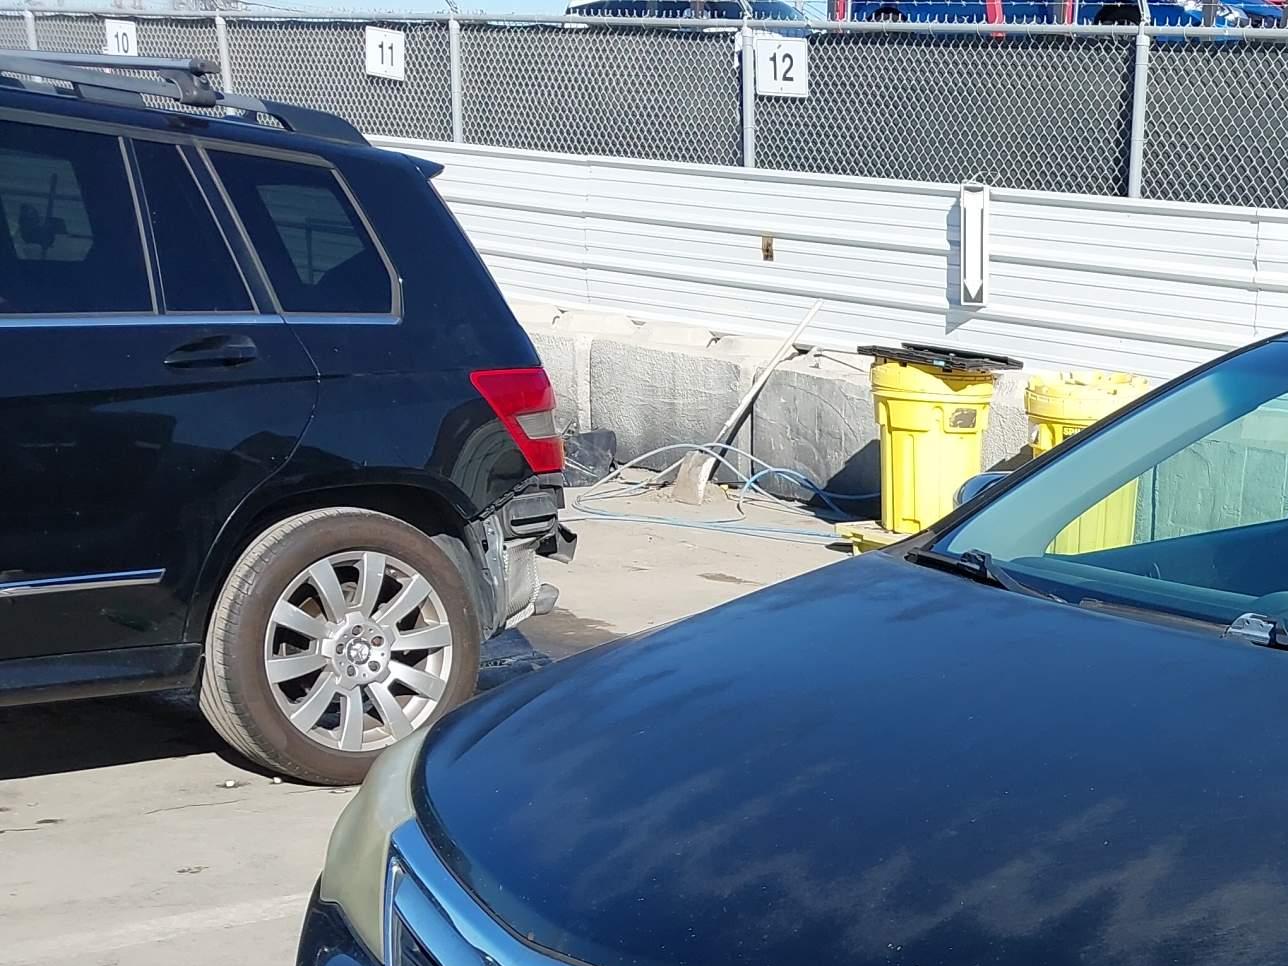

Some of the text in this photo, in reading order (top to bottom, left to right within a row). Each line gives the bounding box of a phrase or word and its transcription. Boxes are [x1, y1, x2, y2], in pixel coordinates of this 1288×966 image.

[114, 31, 129, 54] 10
[378, 41, 394, 67] 11
[769, 52, 794, 82] 12
